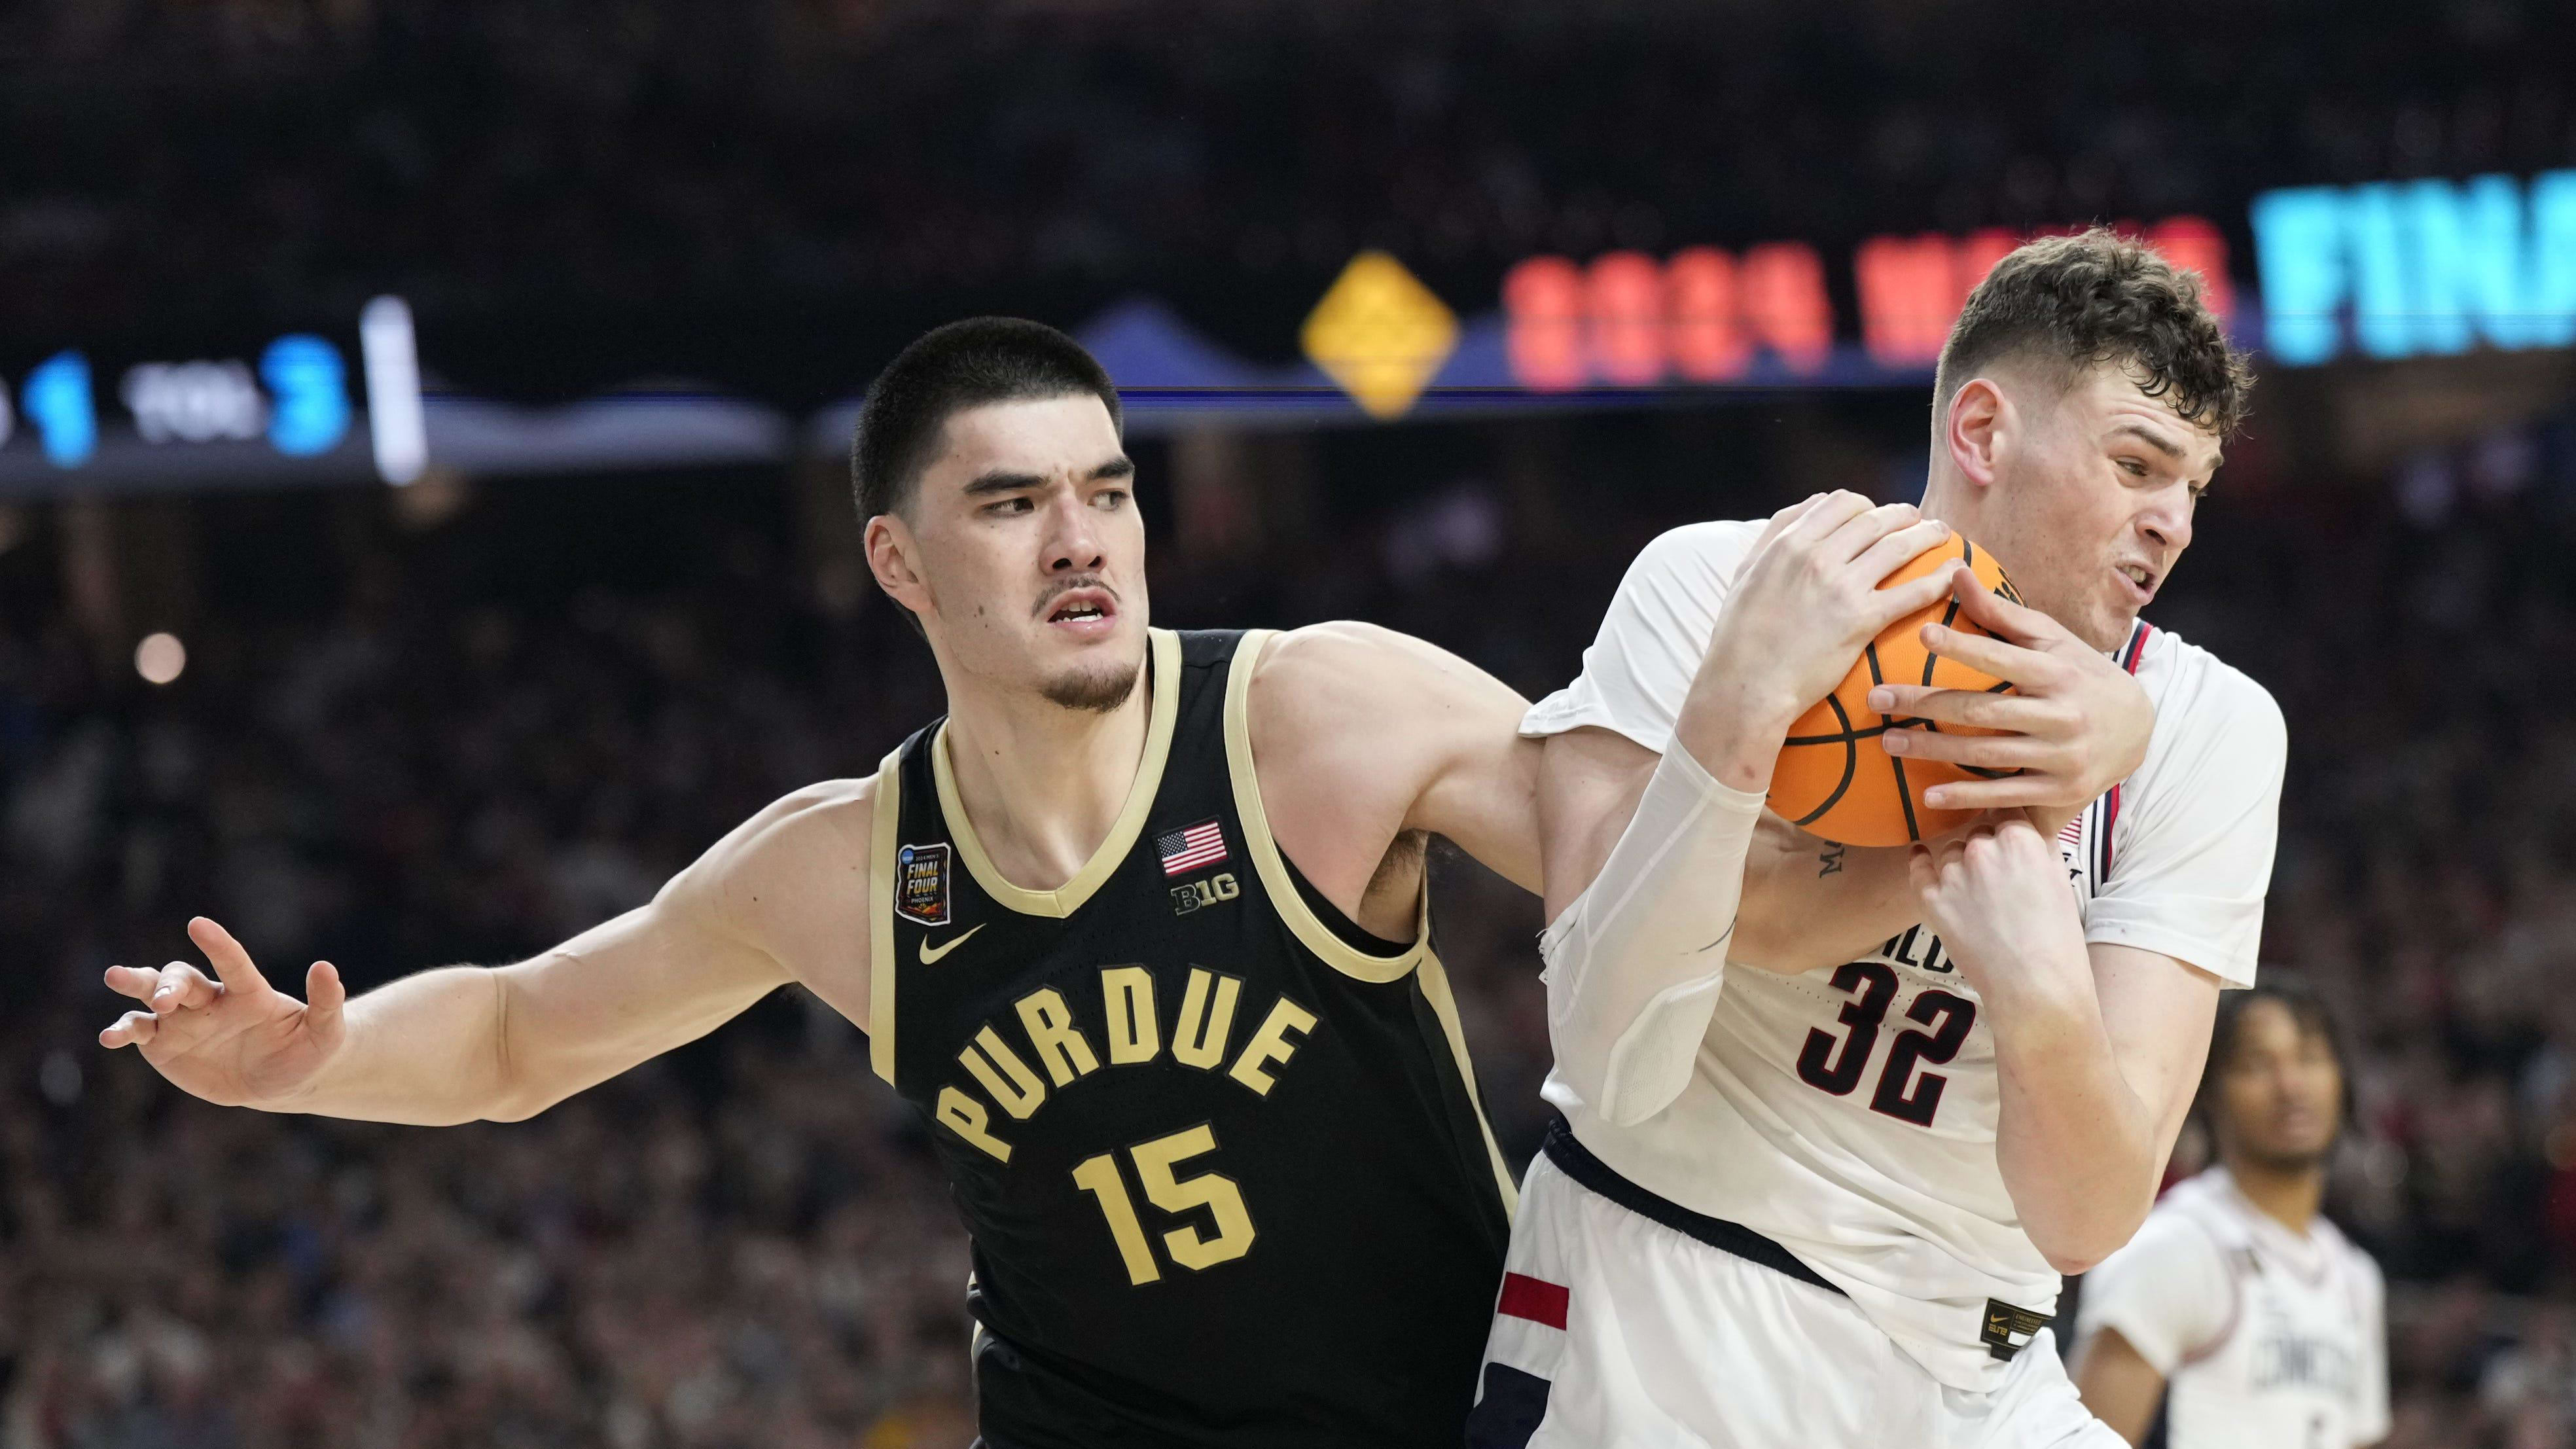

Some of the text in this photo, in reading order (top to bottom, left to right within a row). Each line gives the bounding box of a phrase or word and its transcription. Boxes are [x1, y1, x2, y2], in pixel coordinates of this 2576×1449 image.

[906, 861, 939, 880] FINAL
[906, 876, 938, 895] FOUR
[911, 895, 933, 904] PHOENIX
[935, 963, 1319, 1165] PURDUE
[1796, 961, 1977, 1128] 32
[1069, 1121, 1259, 1287] 15
